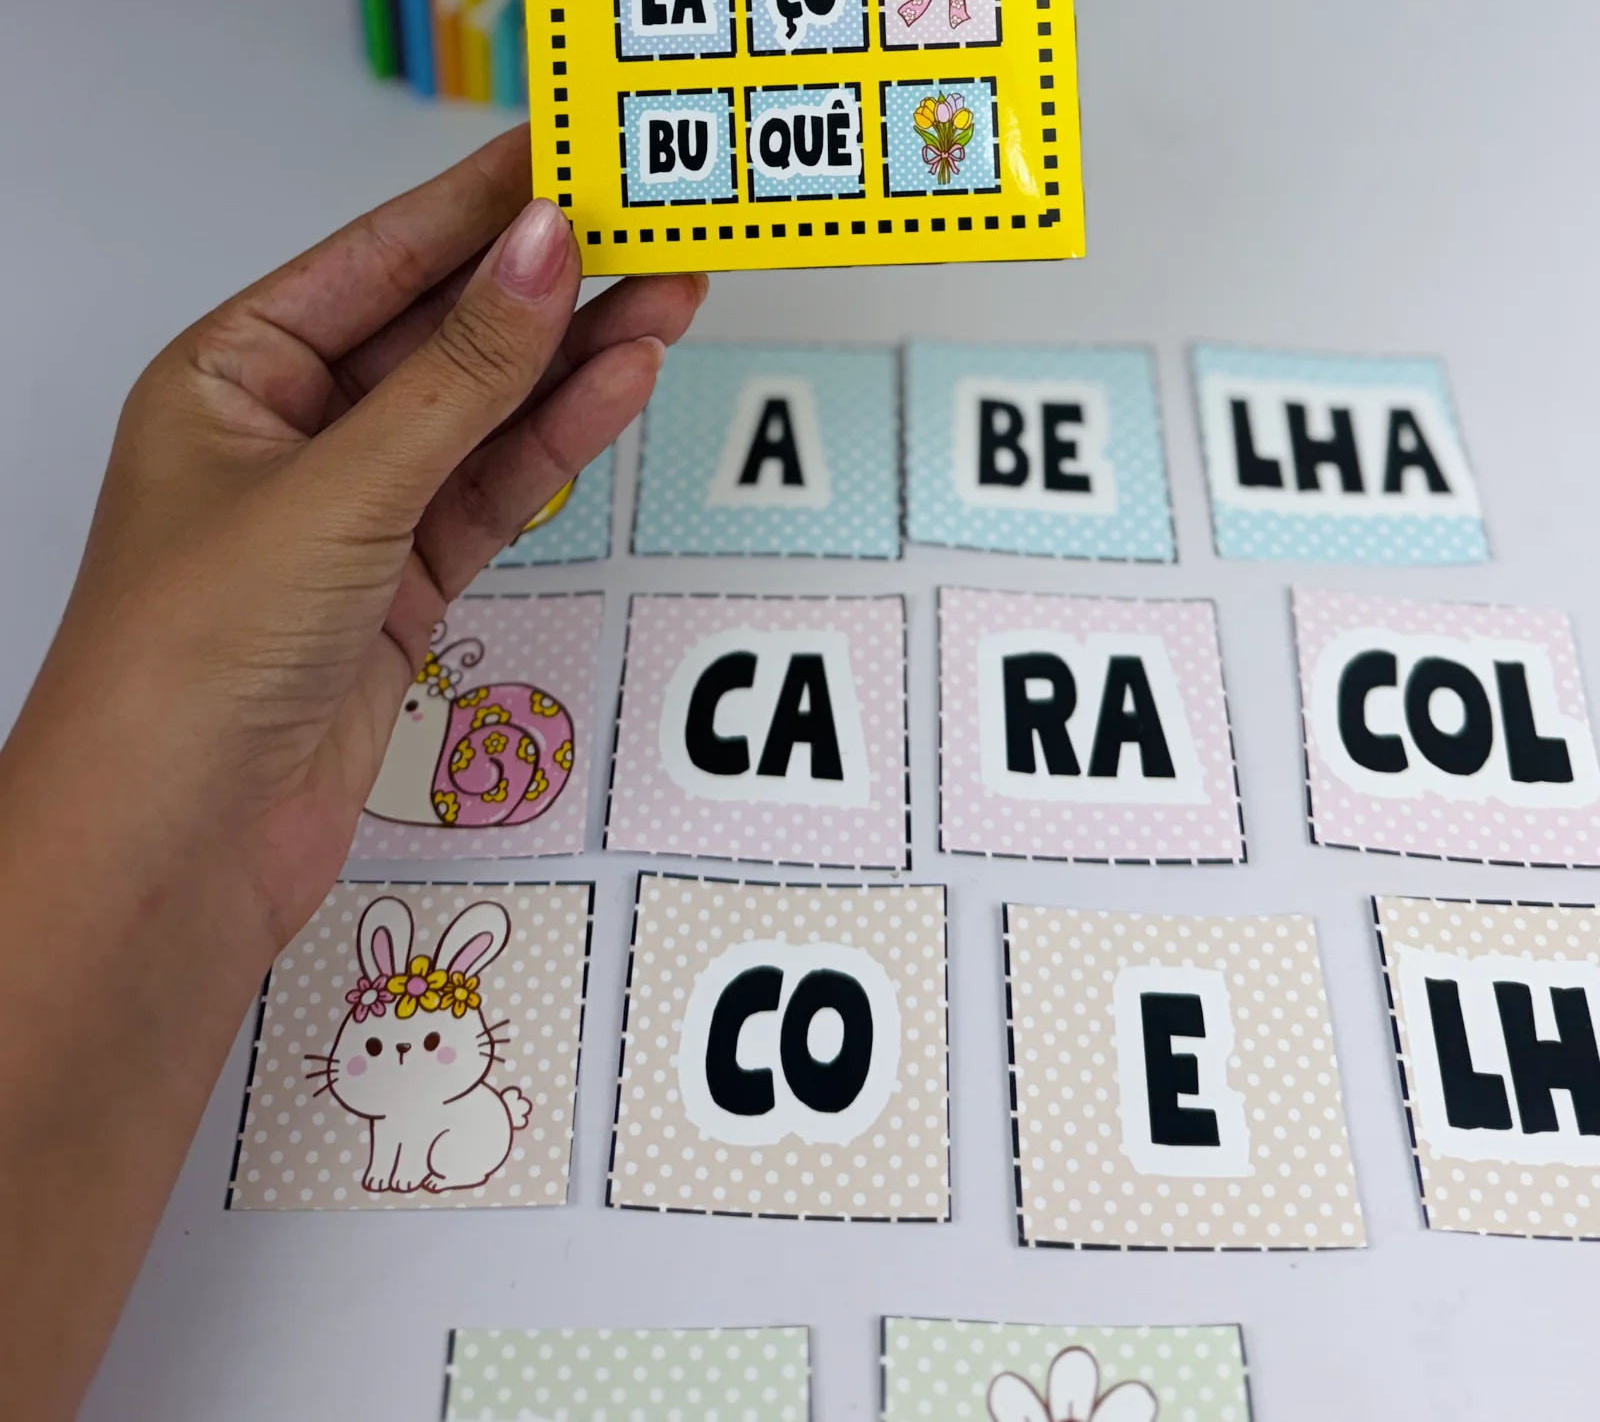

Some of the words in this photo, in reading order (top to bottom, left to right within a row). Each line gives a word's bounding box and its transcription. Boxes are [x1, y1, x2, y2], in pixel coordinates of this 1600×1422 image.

[649, 119, 709, 175] BU
[759, 101, 853, 170] QUÊ
[737, 398, 805, 486] A
[977, 398, 1093, 494] BE
[1230, 399, 1451, 494] LHA
[684, 650, 845, 782] CA
[1002, 652, 1177, 780] RA
[1337, 649, 1575, 785] COL
[704, 965, 875, 1117] CO
[1139, 992, 1222, 1148] E
